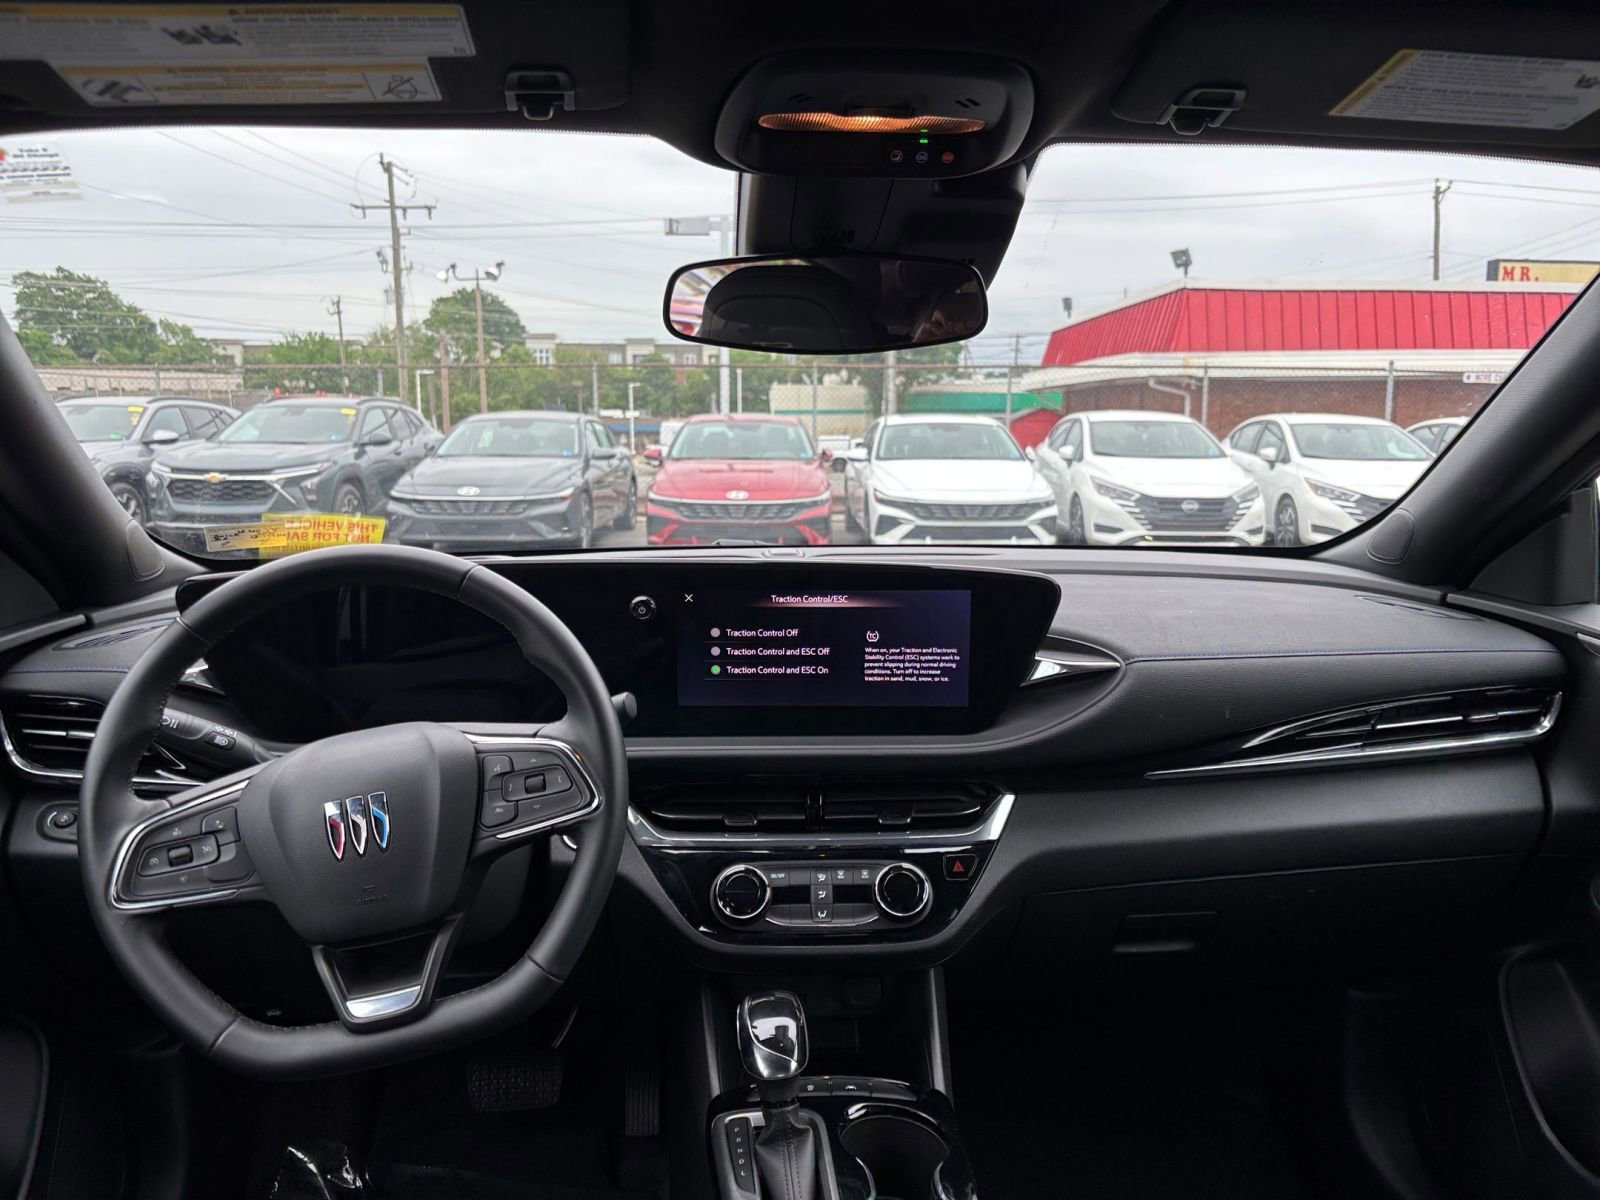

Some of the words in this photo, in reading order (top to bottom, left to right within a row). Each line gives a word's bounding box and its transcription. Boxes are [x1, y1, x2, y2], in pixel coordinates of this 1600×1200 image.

[1502, 266, 1540, 282] MR.
[770, 595, 802, 603] Traction
[802, 595, 848, 603] Control/ESC
[726, 628, 756, 637] Traction
[757, 628, 784, 637] Control
[786, 628, 799, 637] Off
[726, 647, 756, 656] Traction
[757, 647, 784, 656] Control
[786, 647, 800, 656] and
[801, 647, 816, 656] ESC
[817, 647, 830, 656] Off
[726, 666, 756, 674] Traction
[757, 666, 784, 674] Control
[786, 666, 800, 674] and
[801, 666, 816, 674] ESC
[817, 666, 829, 674] On
